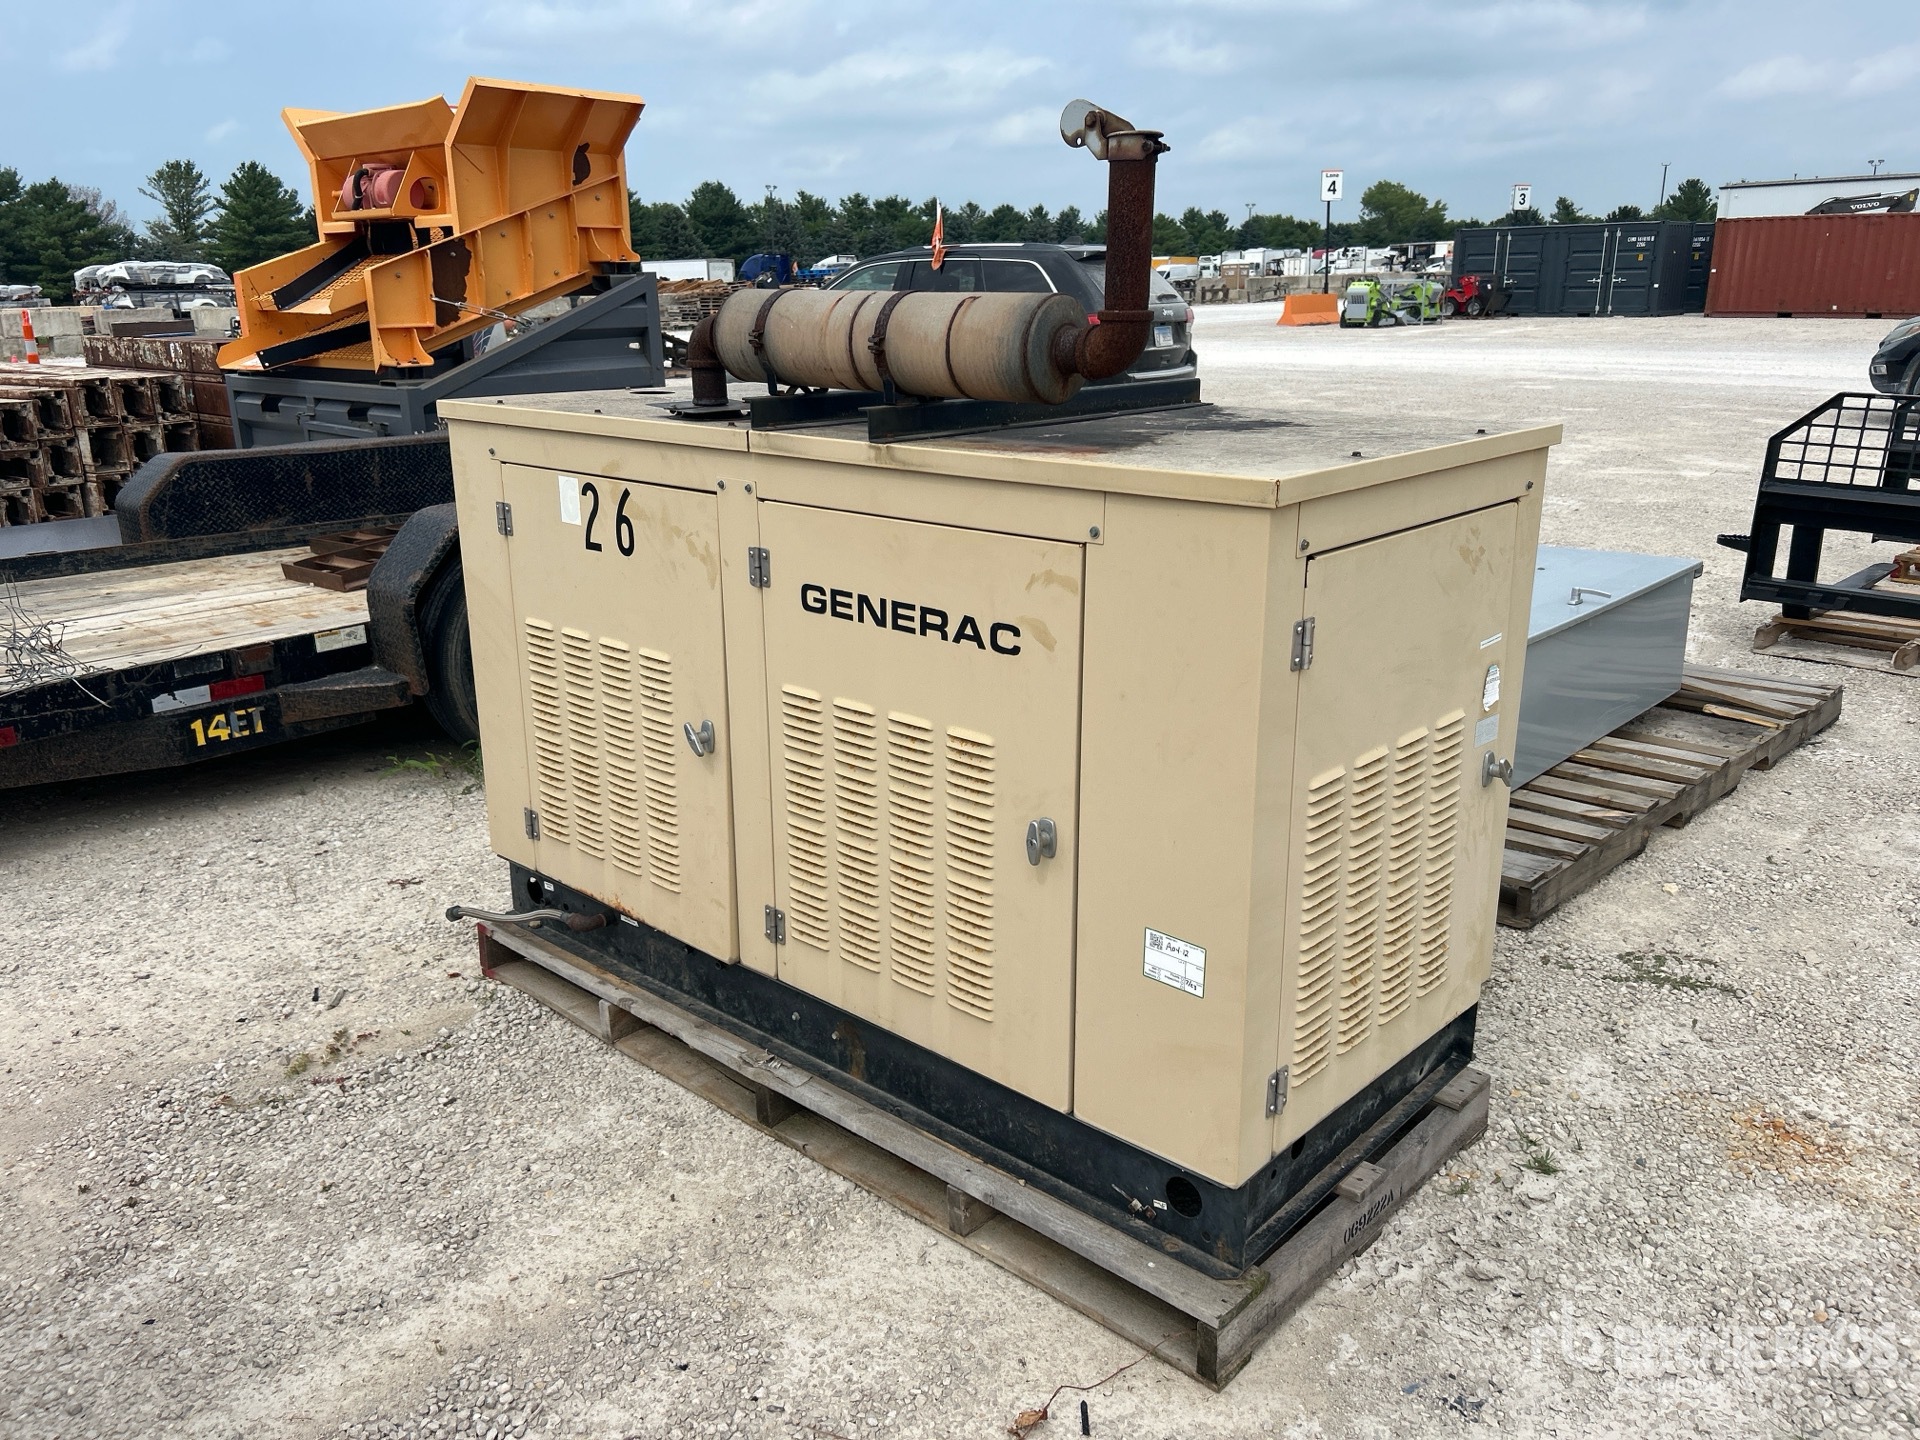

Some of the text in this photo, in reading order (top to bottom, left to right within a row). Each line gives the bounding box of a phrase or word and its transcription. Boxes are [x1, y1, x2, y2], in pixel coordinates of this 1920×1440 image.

[1327, 180, 1337, 195] 4
[1518, 193, 1526, 205] 3
[1850, 201, 1880, 210] VOLVO
[581, 482, 635, 557] 26
[801, 583, 1021, 656] GENERAC
[190, 706, 266, 747] 14ET
